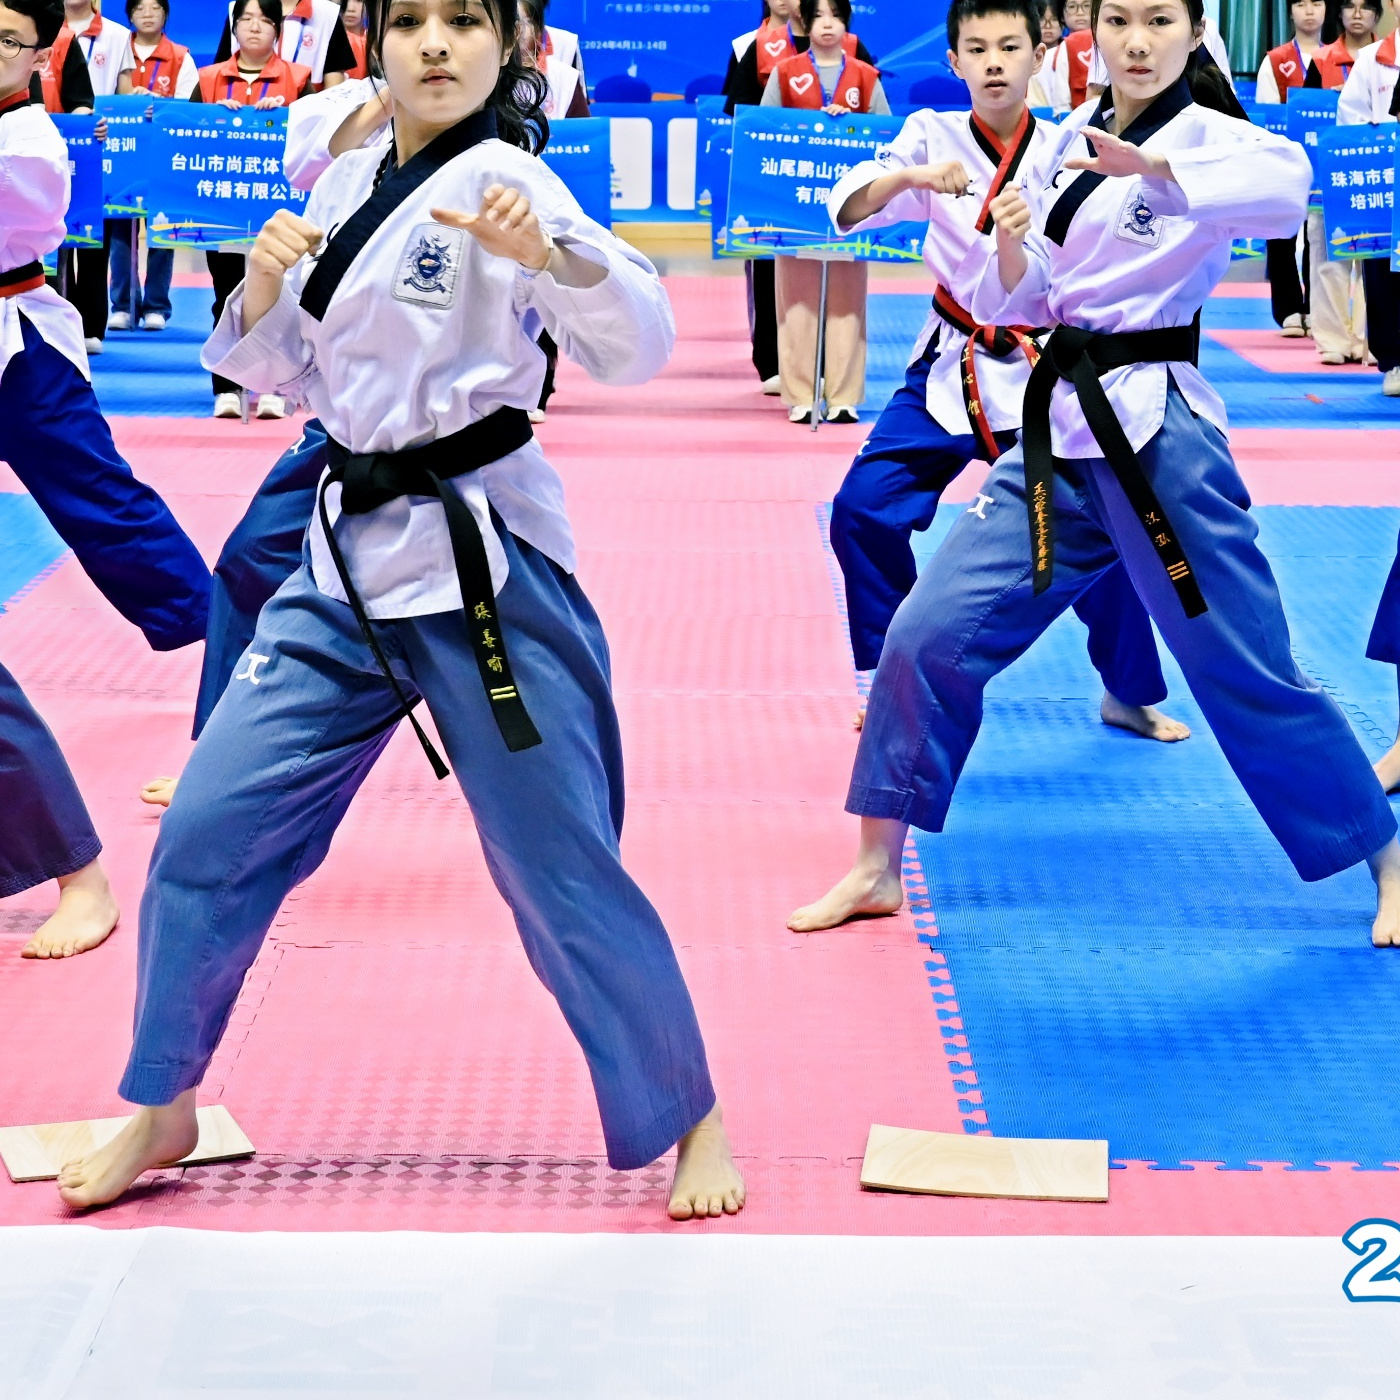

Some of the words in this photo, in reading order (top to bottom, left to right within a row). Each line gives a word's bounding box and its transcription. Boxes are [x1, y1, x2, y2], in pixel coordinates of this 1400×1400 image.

[171, 152, 286, 176] 台山市尚武体
[760, 157, 854, 180] 汕尾鹏山体
[196, 179, 306, 203] 传播有限公司
[795, 186, 831, 205] 有限
